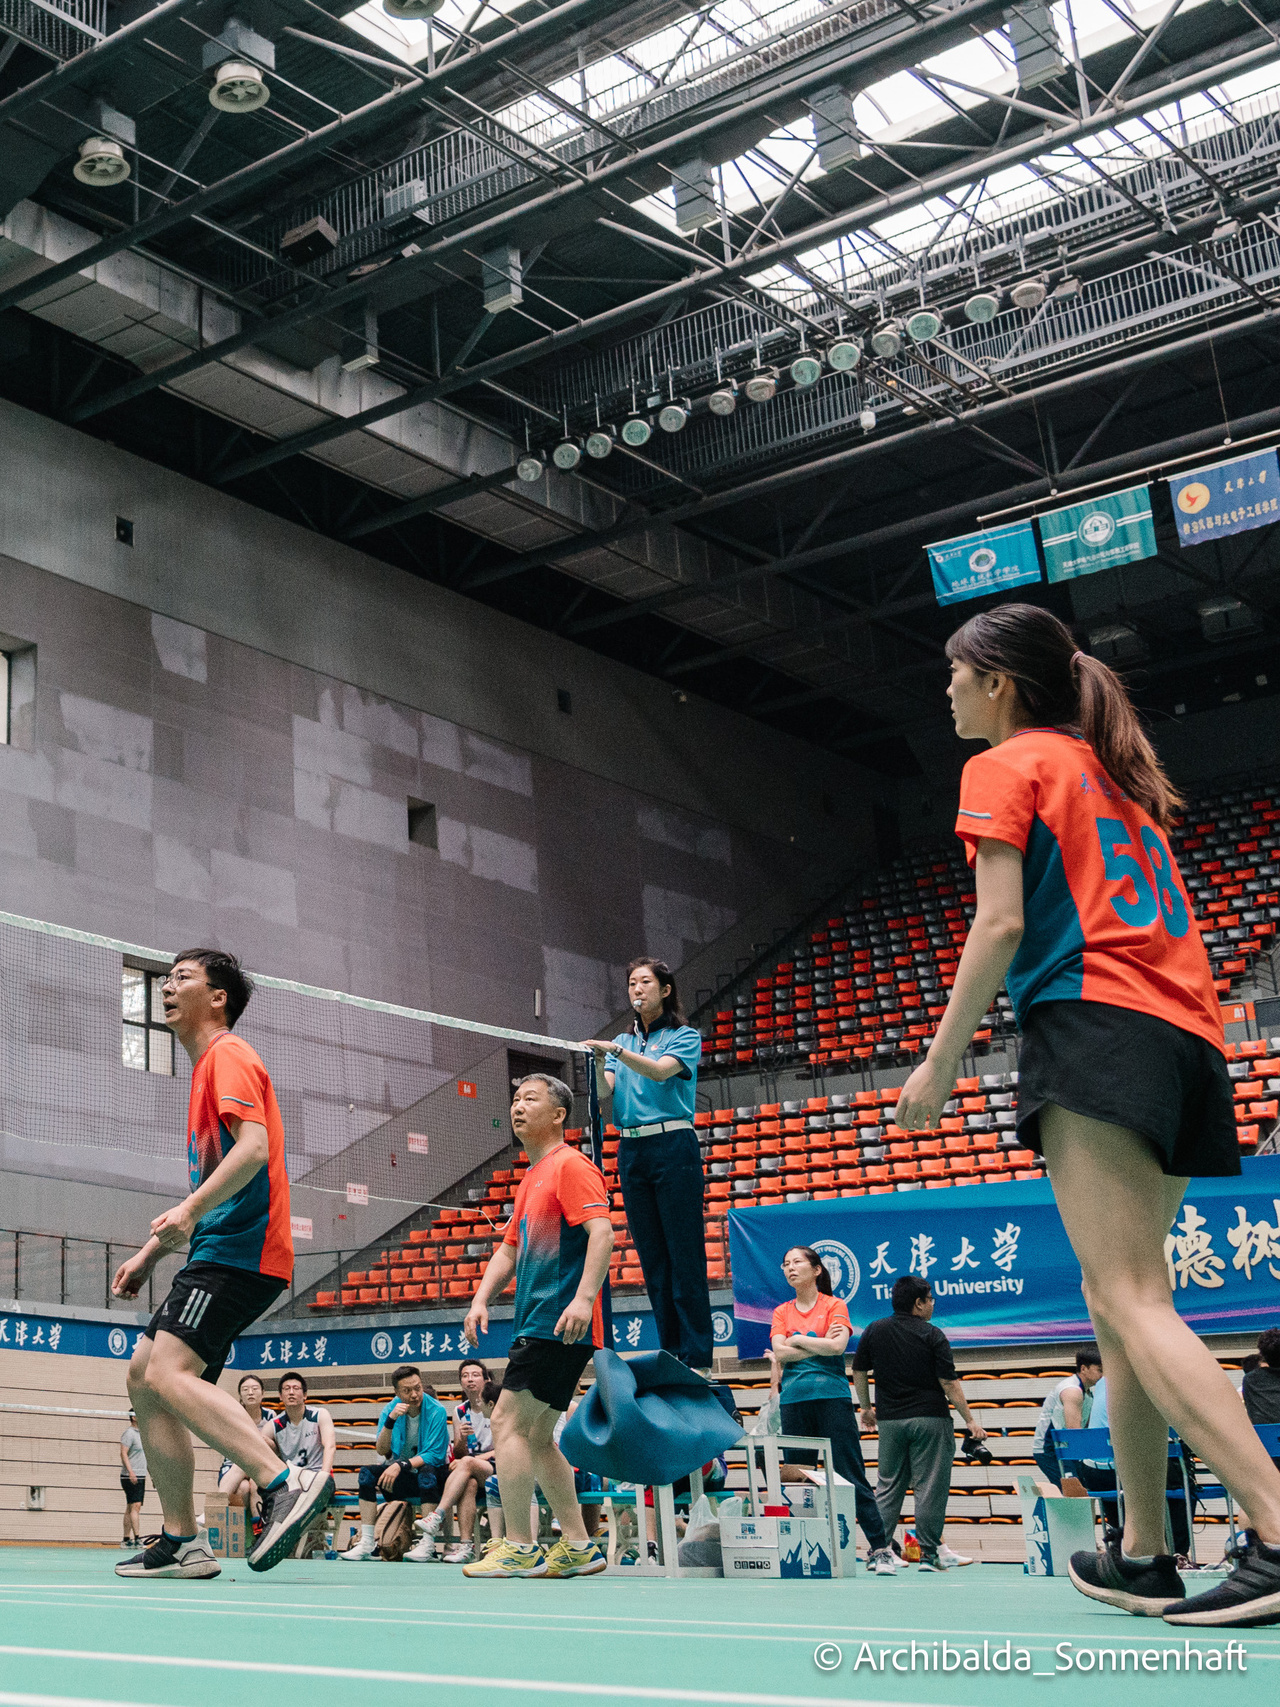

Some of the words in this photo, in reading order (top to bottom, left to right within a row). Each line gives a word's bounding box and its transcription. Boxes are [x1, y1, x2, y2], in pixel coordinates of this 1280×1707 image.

[1096, 817, 1189, 938] 58
[869, 1222, 1021, 1279] 天津大学
[934, 1276, 1024, 1297] University
[260, 1335, 328, 1365] 天津大学
